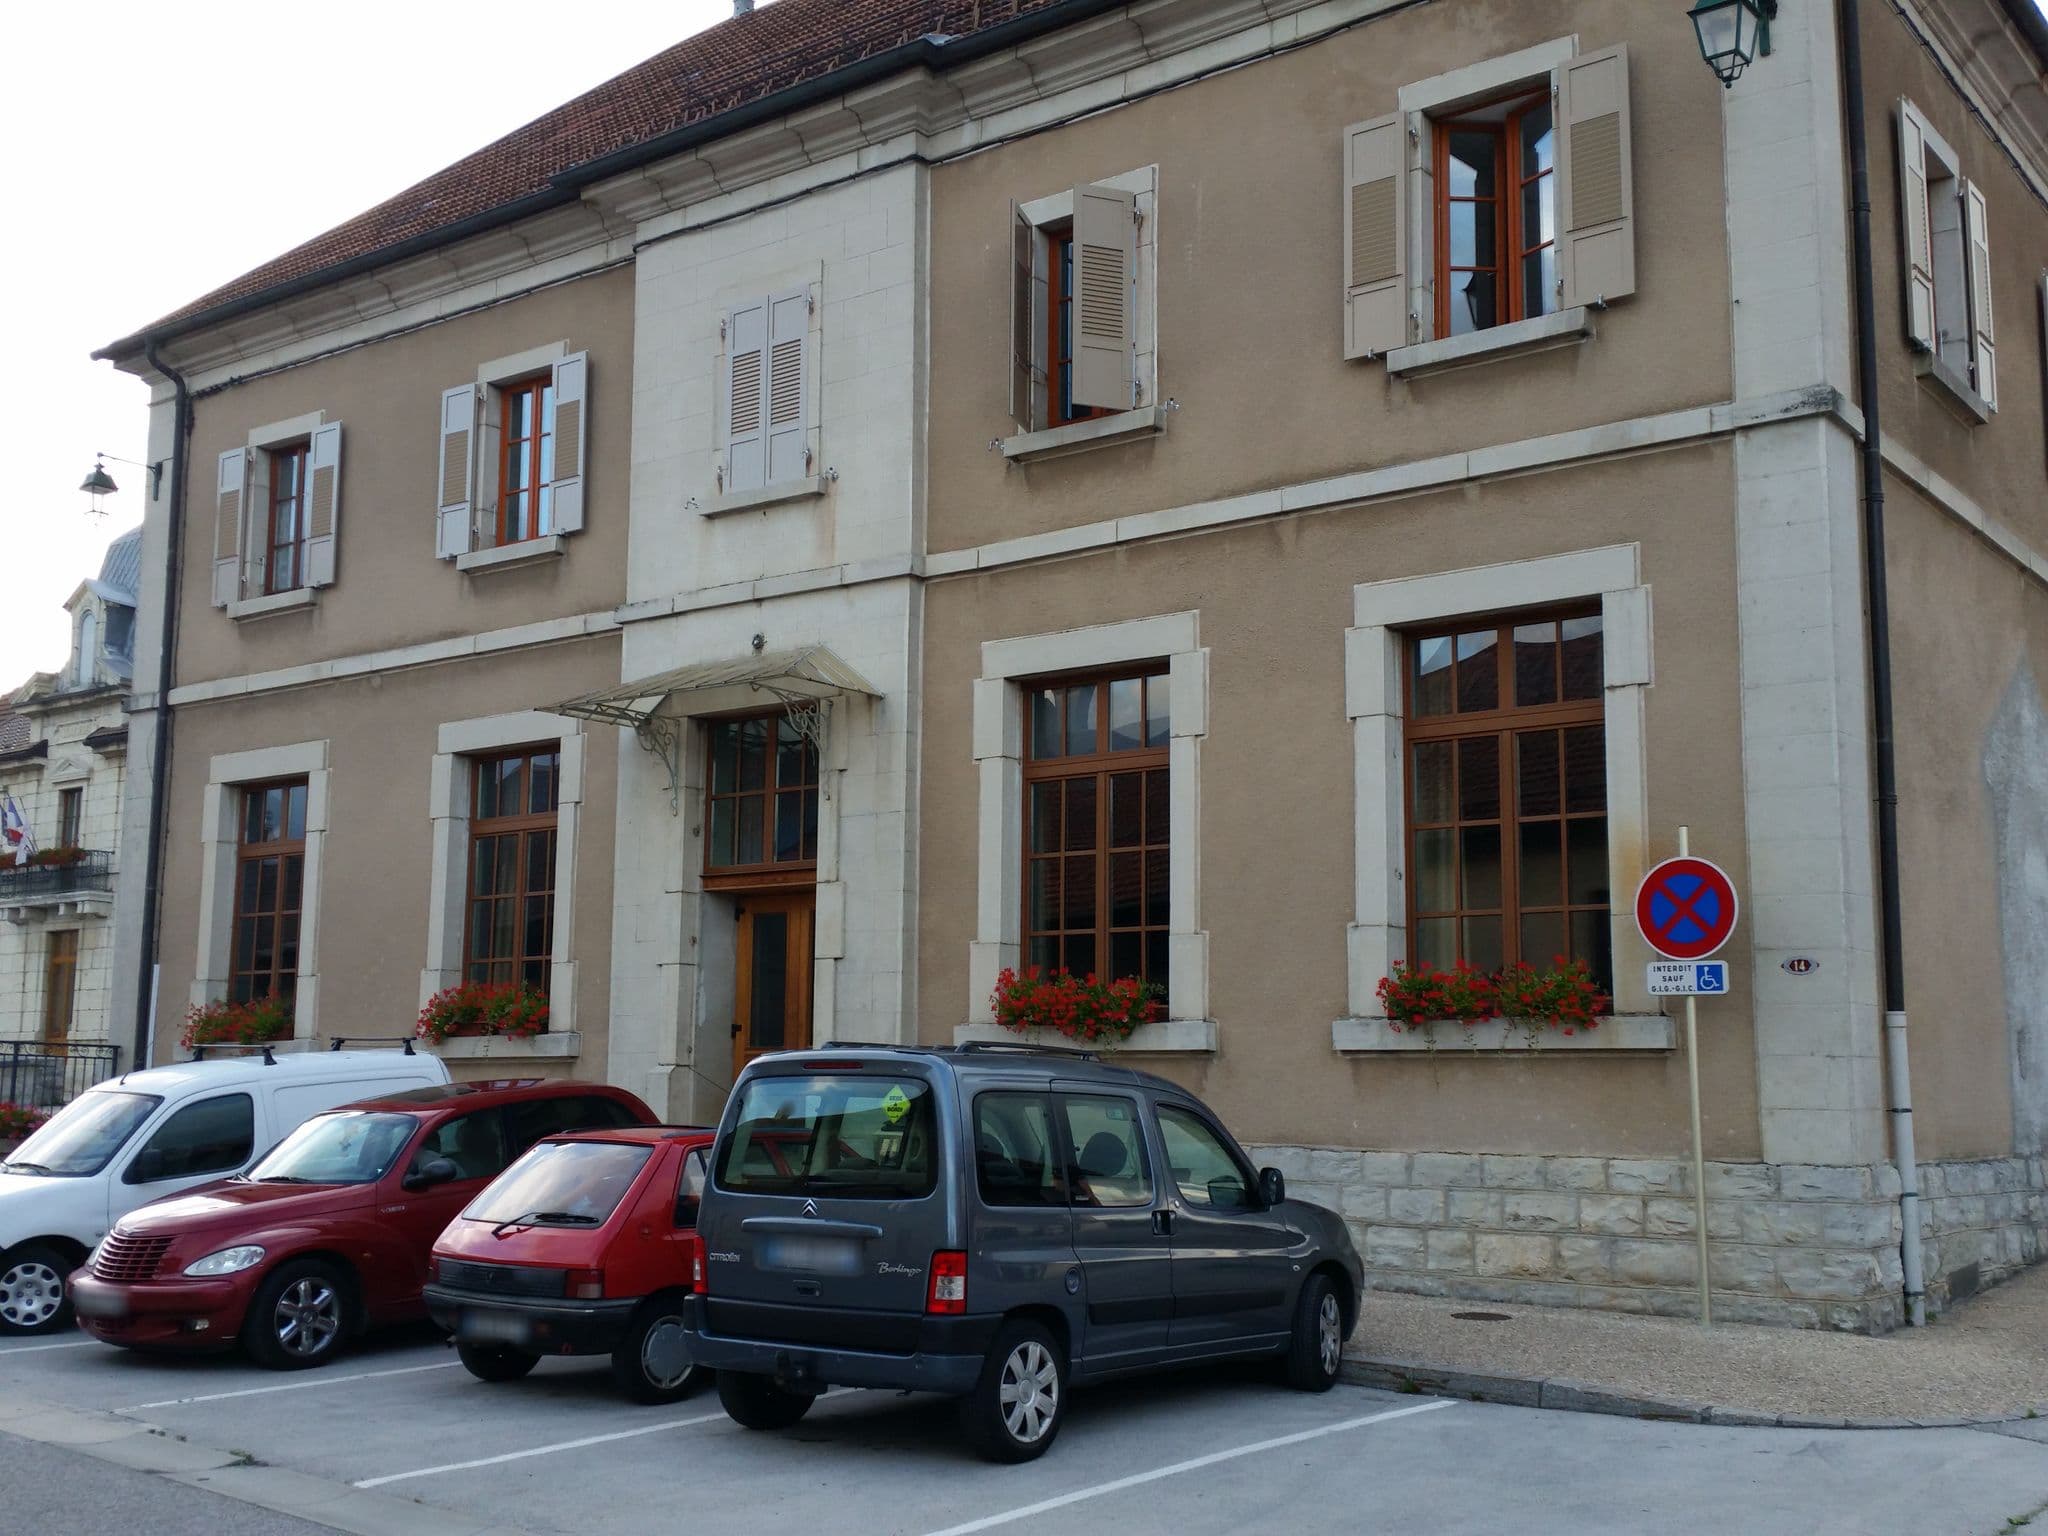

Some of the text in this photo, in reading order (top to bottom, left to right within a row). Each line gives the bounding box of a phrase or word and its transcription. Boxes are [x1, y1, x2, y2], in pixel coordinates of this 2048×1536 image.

[1653, 964, 1692, 972] INTERDIT
[1794, 960, 1805, 970] 14
[877, 1261, 922, 1277] Berlingo
